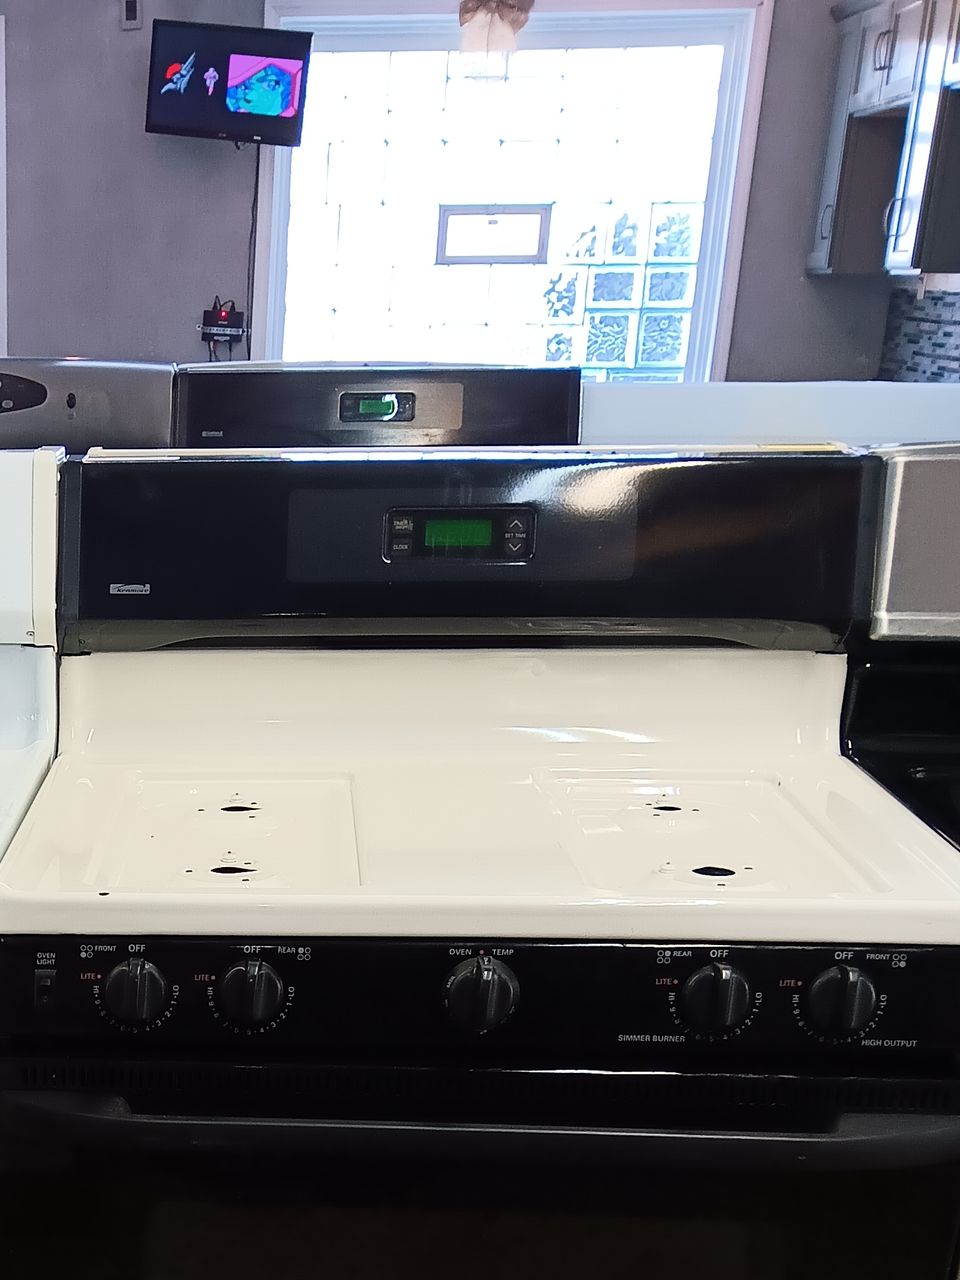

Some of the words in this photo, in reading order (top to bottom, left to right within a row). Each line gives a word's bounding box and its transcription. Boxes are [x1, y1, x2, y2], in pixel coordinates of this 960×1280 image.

[128, 944, 146, 953] OFF
[243, 945, 261, 954] OFF
[278, 946, 296, 954] REAR
[448, 948, 472, 956] OVEN
[491, 948, 515, 956] TEMP
[709, 949, 729, 958] OFF
[834, 951, 854, 960] OFF
[172, 984, 180, 996] LO
[288, 986, 295, 997] LO
[755, 992, 762, 1003] LO
[879, 994, 888, 1005] LO
[617, 1034, 651, 1042] SIMMER
[652, 1035, 686, 1043] BURNER
[861, 1039, 882, 1047] HIGH
[883, 1039, 918, 1047] OUTPUT
